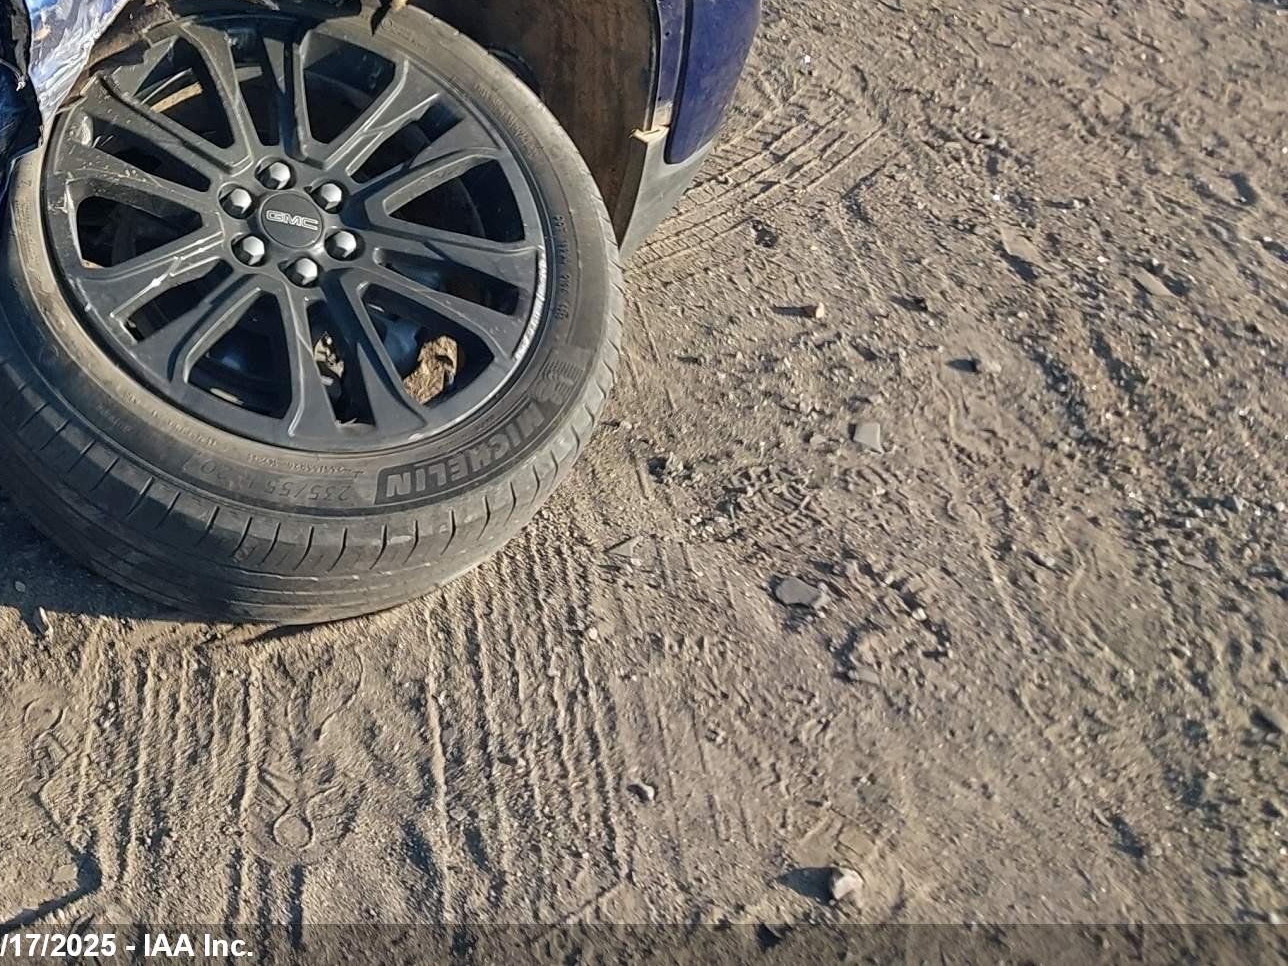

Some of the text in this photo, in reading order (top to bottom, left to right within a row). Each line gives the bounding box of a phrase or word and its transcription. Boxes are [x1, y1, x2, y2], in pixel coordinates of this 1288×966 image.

[265, 209, 319, 231] GMC
[385, 401, 546, 498] MICHELIN
[263, 480, 352, 502] 235/55
